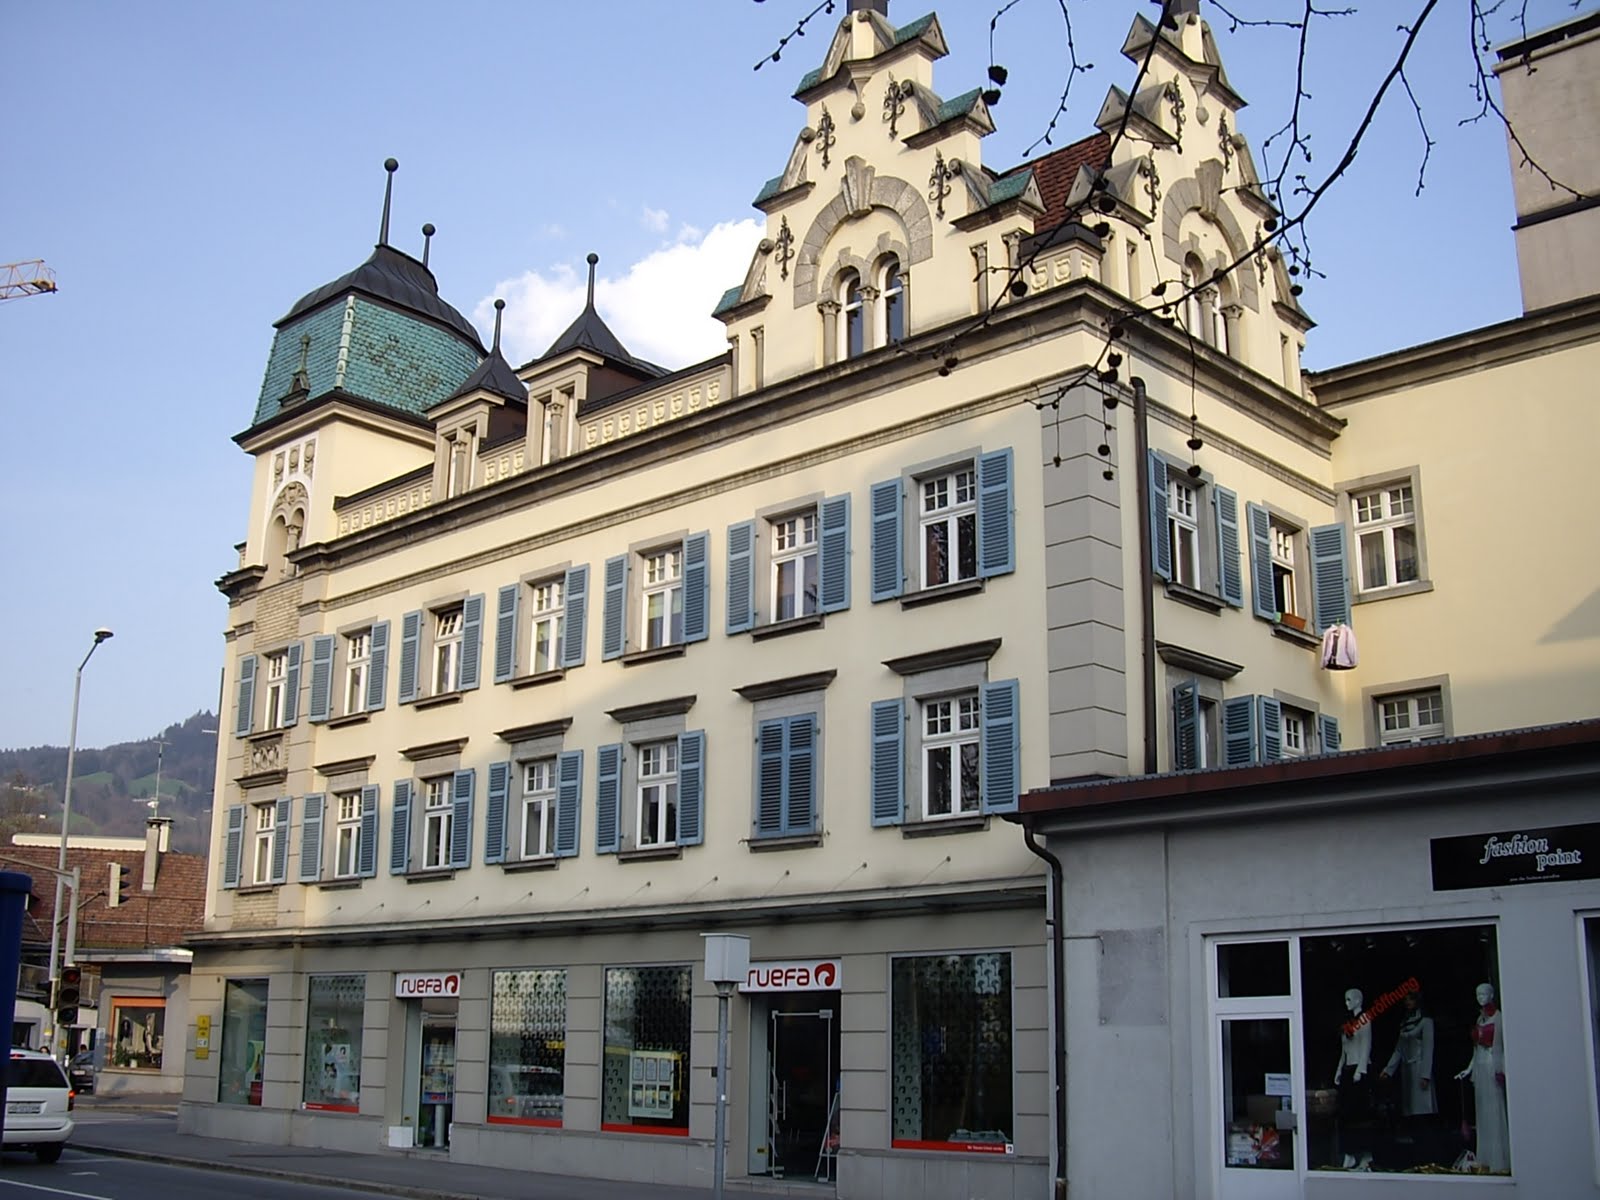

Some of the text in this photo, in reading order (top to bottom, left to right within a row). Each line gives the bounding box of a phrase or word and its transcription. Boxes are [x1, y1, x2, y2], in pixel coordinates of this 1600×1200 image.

[1479, 833, 1549, 864] fashion
[1536, 848, 1582, 871] point
[402, 978, 442, 994] ruefa
[748, 968, 810, 987] ruefa
